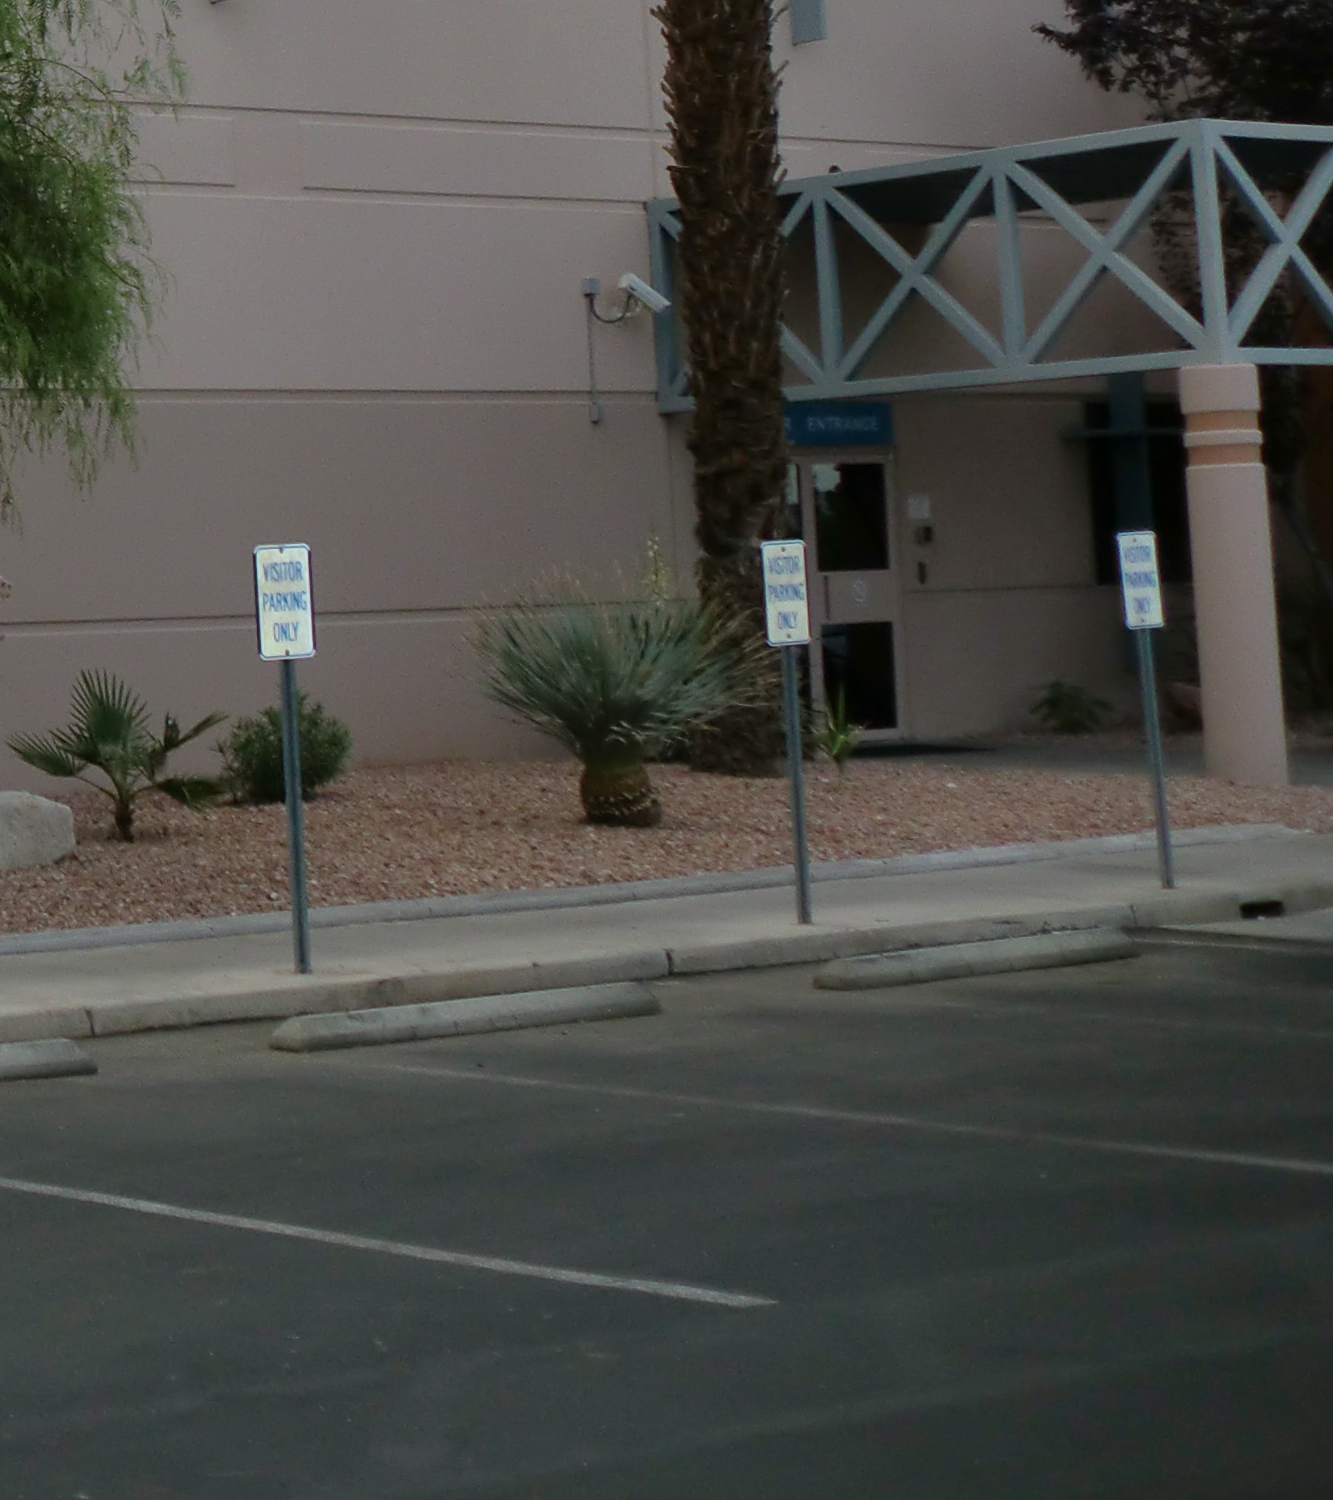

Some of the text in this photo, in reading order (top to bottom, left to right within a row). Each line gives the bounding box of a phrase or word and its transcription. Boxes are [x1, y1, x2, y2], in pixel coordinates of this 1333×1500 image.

[1124, 545, 1152, 564] VISITOR
[263, 561, 303, 582] VISITOR
[768, 556, 801, 575] VISITOR
[1124, 571, 1157, 589] PARKING
[262, 591, 308, 612] PARKING
[768, 583, 806, 602] PARKING
[777, 611, 798, 631] ONLY
[273, 622, 299, 643] ONLY
